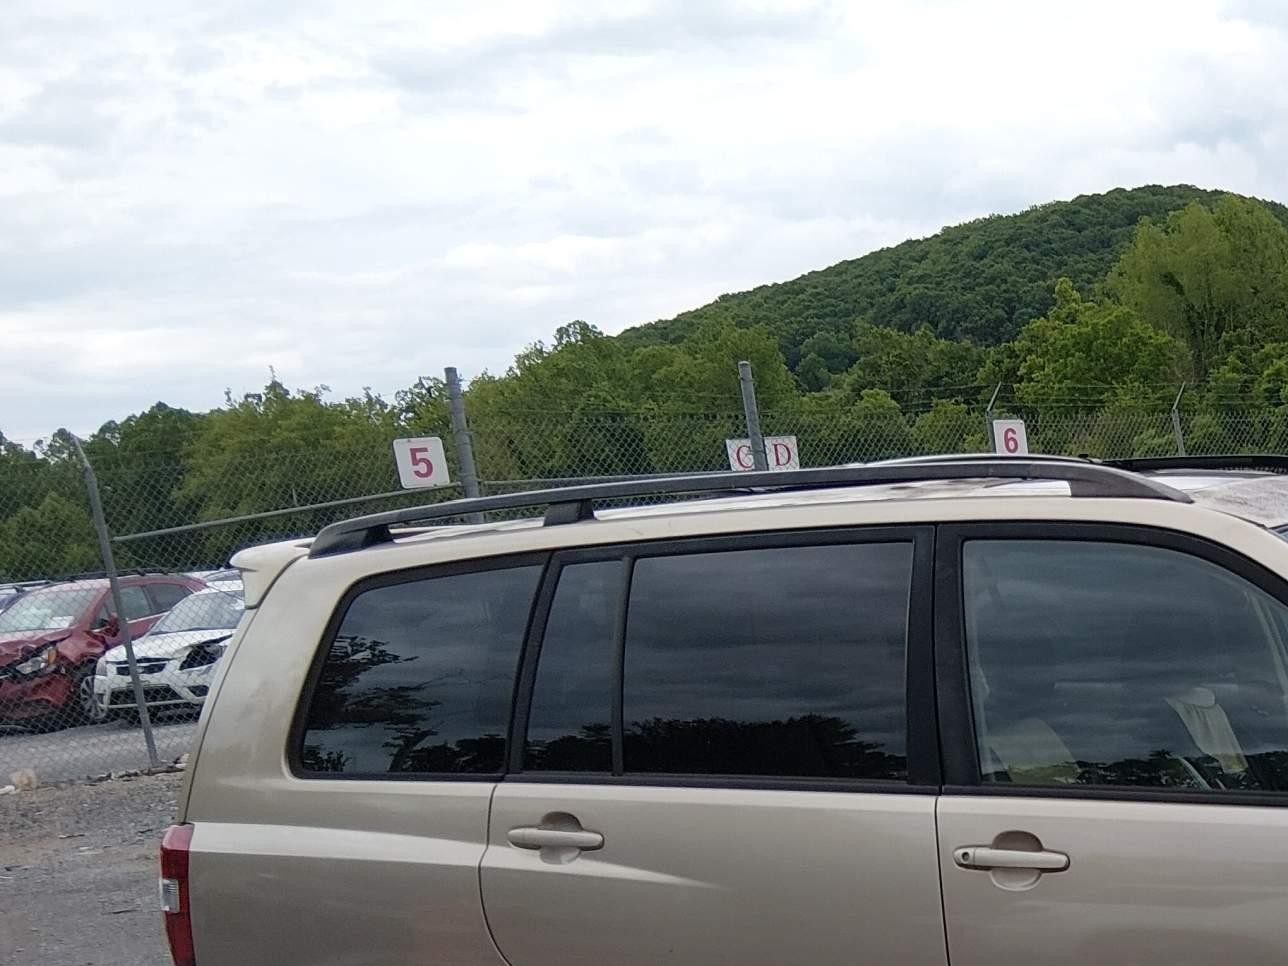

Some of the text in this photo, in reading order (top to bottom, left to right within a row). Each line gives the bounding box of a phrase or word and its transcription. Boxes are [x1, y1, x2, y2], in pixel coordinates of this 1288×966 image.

[1003, 427, 1019, 454] 6
[409, 447, 434, 479] 5
[771, 442, 792, 467] D
